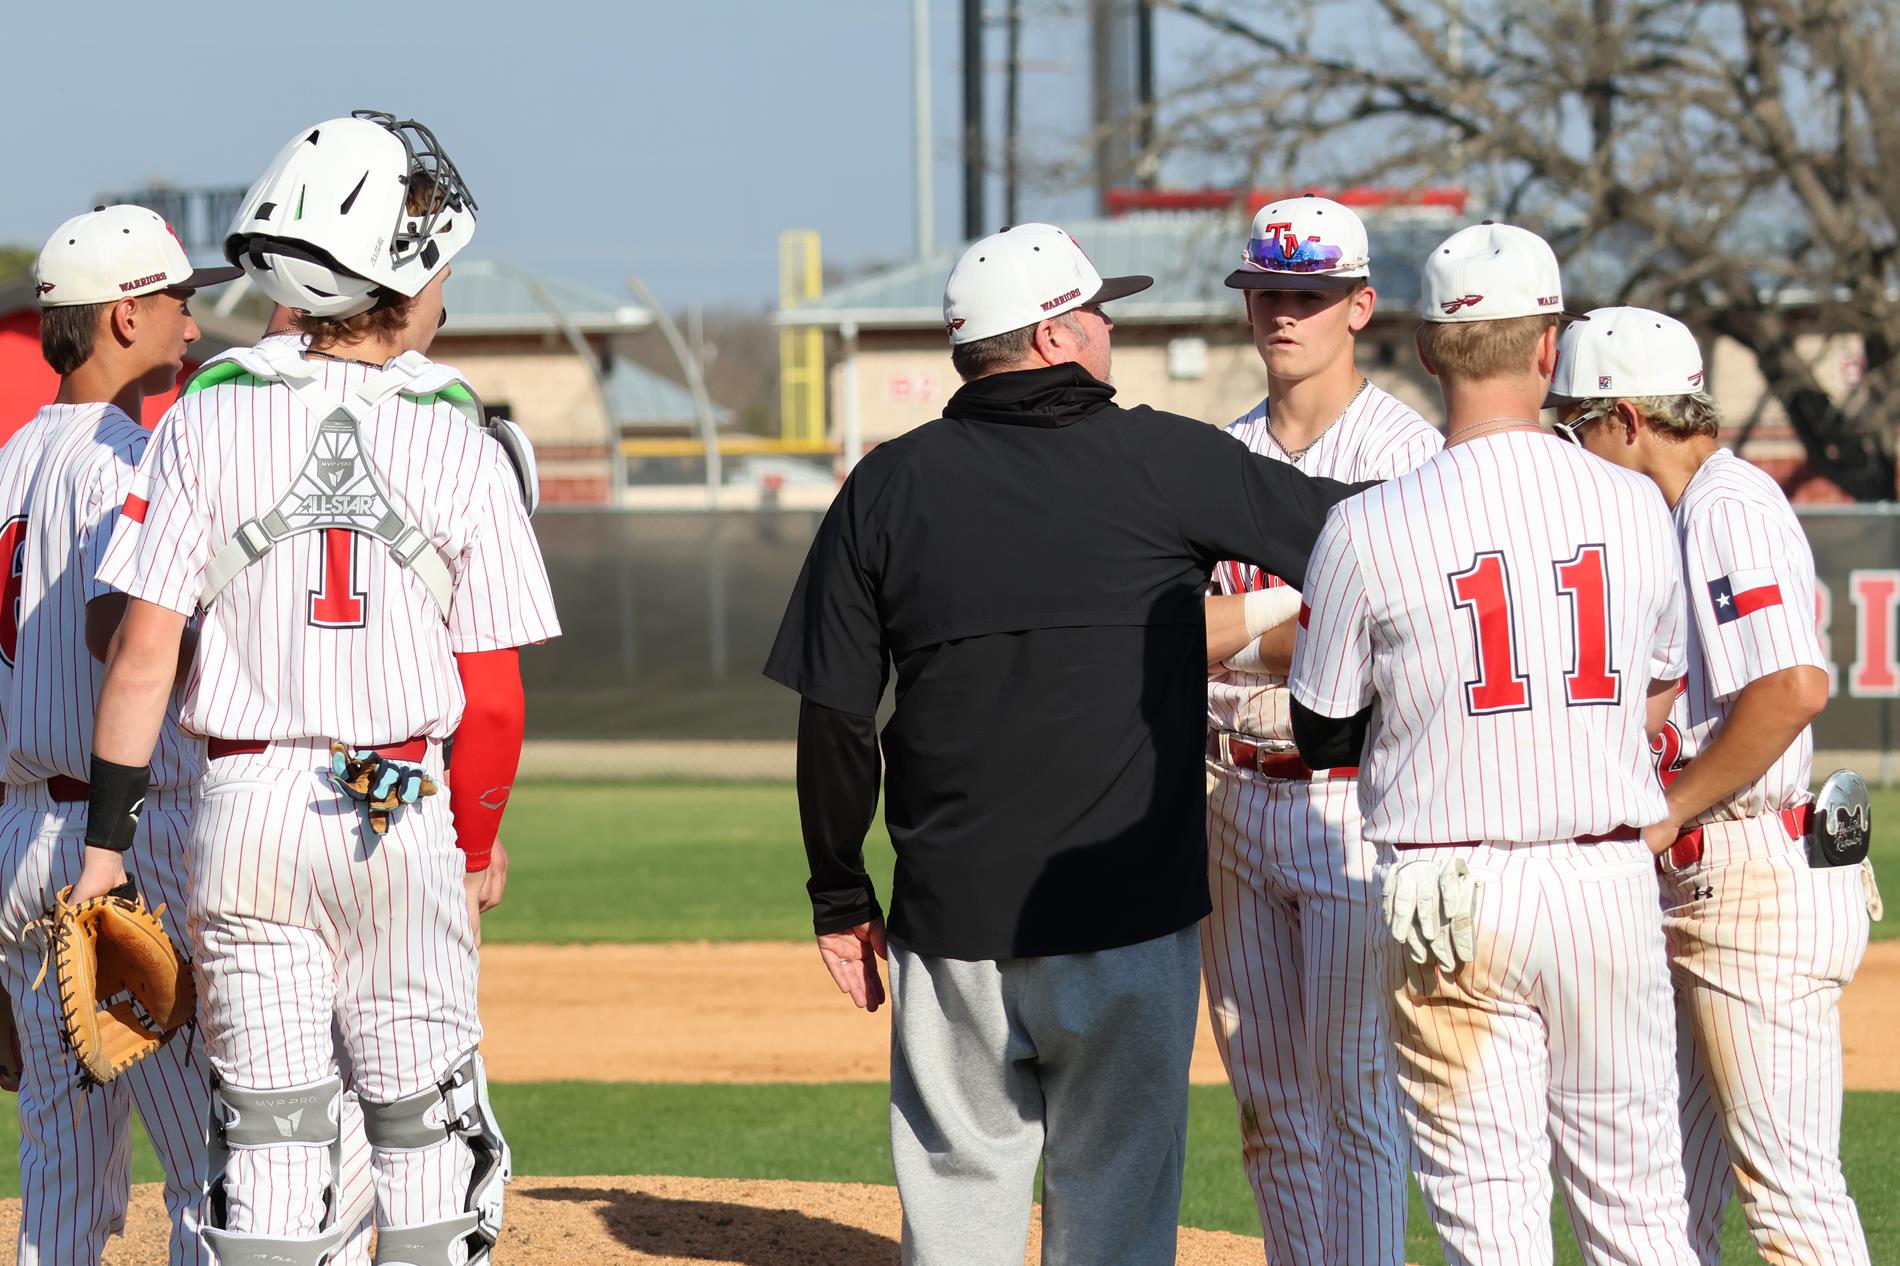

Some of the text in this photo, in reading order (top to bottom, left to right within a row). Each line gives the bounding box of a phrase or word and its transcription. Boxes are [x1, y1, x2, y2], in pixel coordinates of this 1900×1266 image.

[119, 272, 167, 292] WARRIORS
[1040, 288, 1081, 312] WARRIORS
[301, 495, 373, 515] ALL-STAR
[1447, 543, 1622, 717] 11
